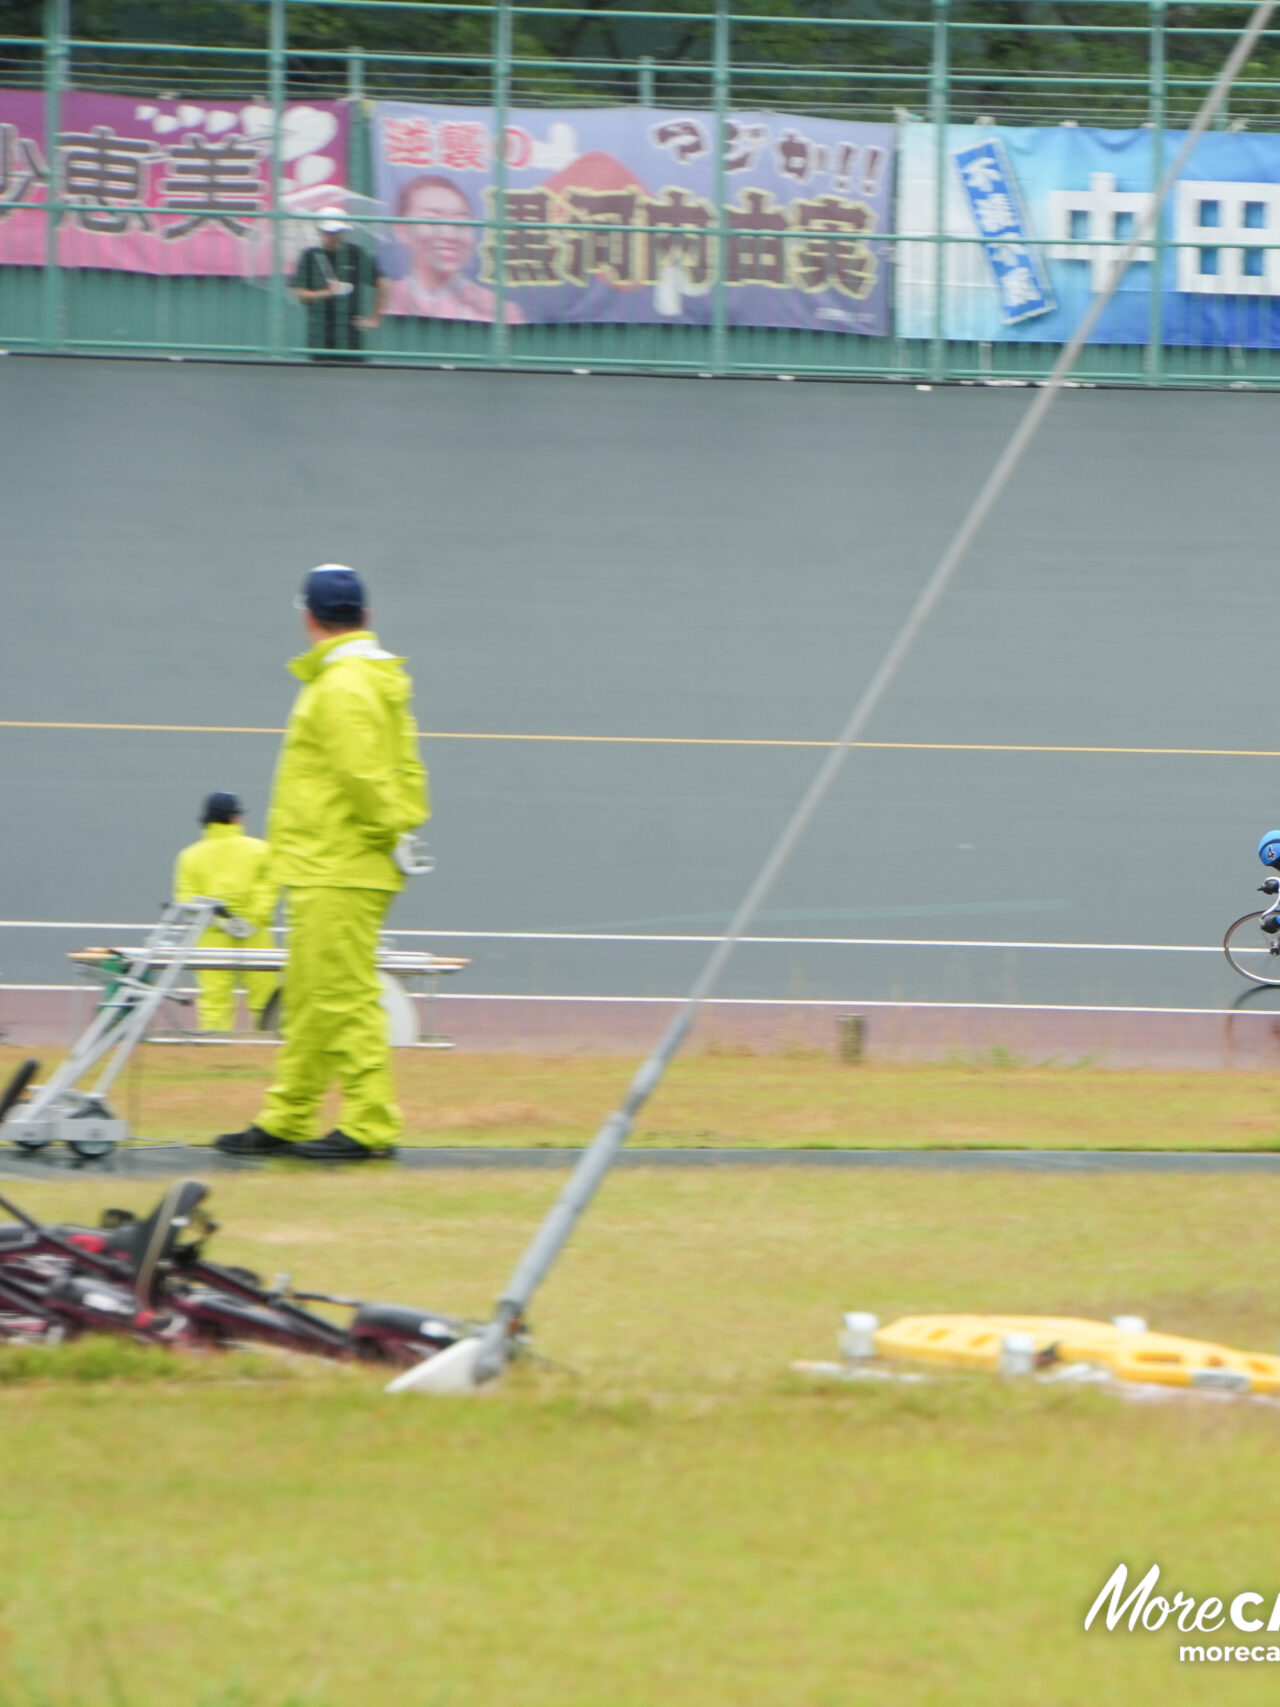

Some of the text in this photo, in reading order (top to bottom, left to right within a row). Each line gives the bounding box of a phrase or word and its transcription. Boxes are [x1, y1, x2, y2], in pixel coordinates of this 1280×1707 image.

[478, 185, 878, 299] 黒河内由実
[1266, 847, 1275, 860] 4
